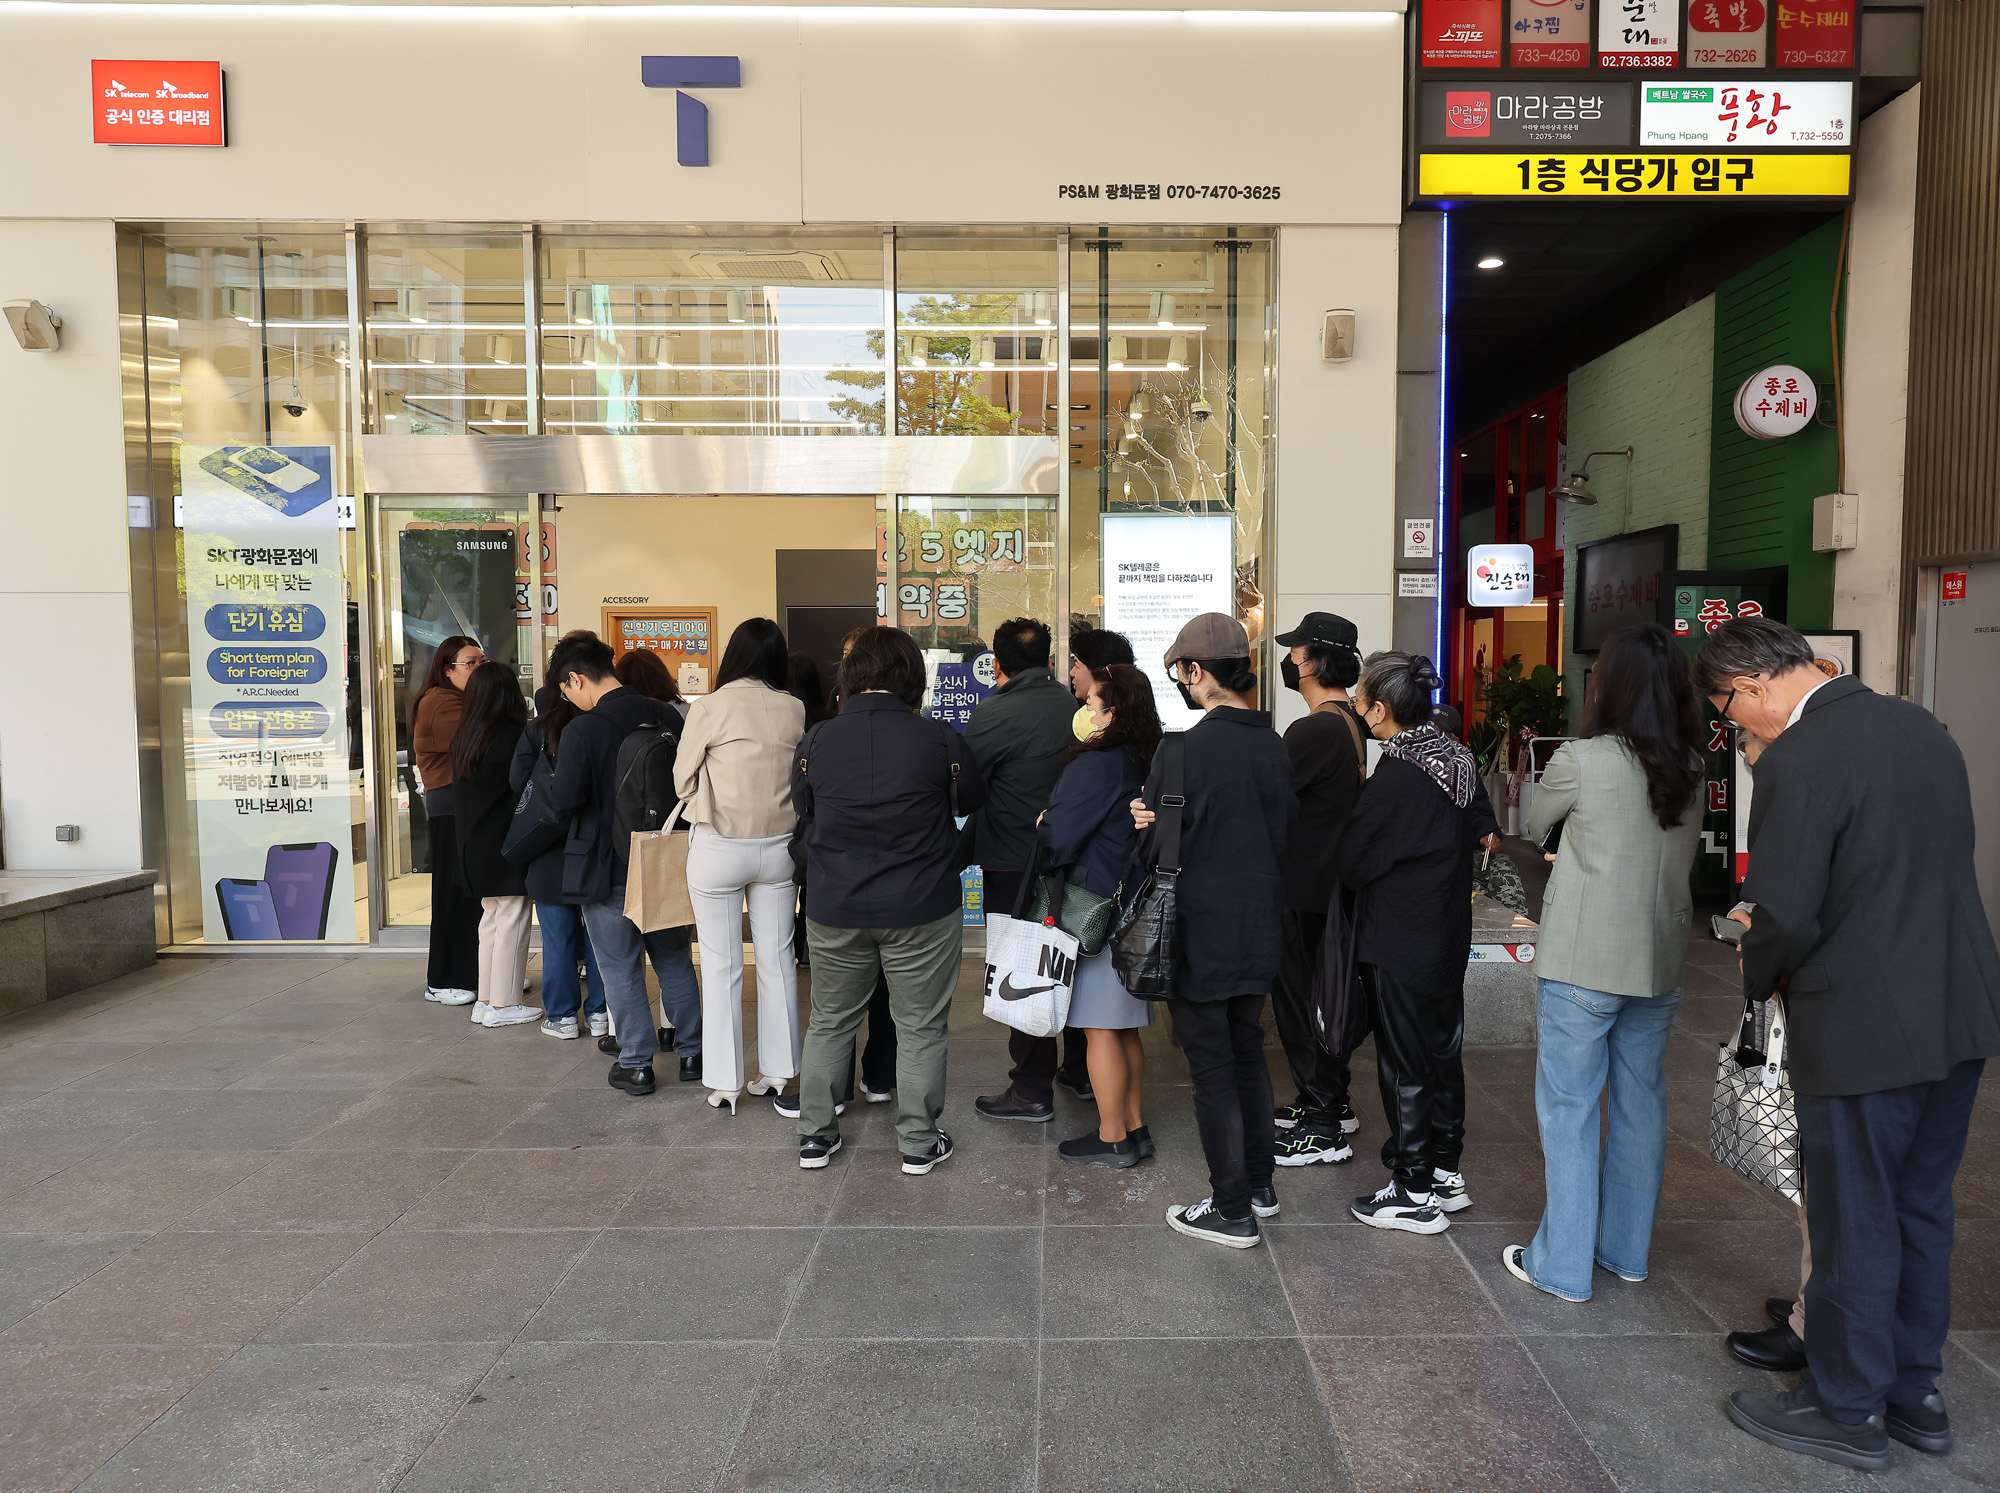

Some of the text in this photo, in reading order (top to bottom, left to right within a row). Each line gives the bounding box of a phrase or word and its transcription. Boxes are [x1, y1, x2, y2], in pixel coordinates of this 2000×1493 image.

[1514, 17, 1560, 35] 아구찜
[1438, 28, 1484, 44] 스피또
[1517, 49, 1580, 63] 733-4250
[1601, 56, 1673, 68] 02.736.3382
[1693, 49, 1757, 63] 732-2626
[1783, 50, 1847, 64] 730-6327
[104, 88, 150, 99] SK telecom
[155, 89, 209, 99] SK broadband
[1652, 90, 1709, 100] 베트남 쌀국수
[1452, 104, 1472, 116] 마라
[1496, 95, 1605, 120] 마라공방
[105, 109, 210, 126] 공식 인증 대리점
[1462, 114, 1483, 125] 공방
[1829, 119, 1844, 130] 1층
[1647, 131, 1709, 141] Phung Hpang
[1790, 131, 1844, 142] T.732-5550
[1517, 158, 1754, 193] 1층 식당가 입구
[1058, 184, 1281, 200] PS&M 광화문점 070-7470-3625
[1764, 377, 1801, 396] 종로
[1755, 398, 1808, 418] 수제비
[456, 541, 508, 550] SAMSUNG
[207, 548, 318, 566] SKT광화문점에
[1118, 563, 1160, 572] SK텔레콤은
[215, 573, 260, 591] 나에게
[283, 573, 312, 592] 맞는
[1118, 574, 1213, 583] 끝까지 책임을 다하겠습니다
[1485, 572, 1530, 591] 진순대
[602, 596, 649, 604] ACCESSORY
[227, 611, 304, 633] 단기 유심
[219, 652, 315, 667] Short term plan
[227, 666, 309, 682] for Foreigner
[932, 692, 979, 707] 상관없이
[224, 709, 260, 731] 업무
[958, 709, 972, 724] 환
[217, 774, 278, 791] 저렴하고
[234, 797, 313, 815] 만나보세요!
[1469, 951, 1487, 960] otto
